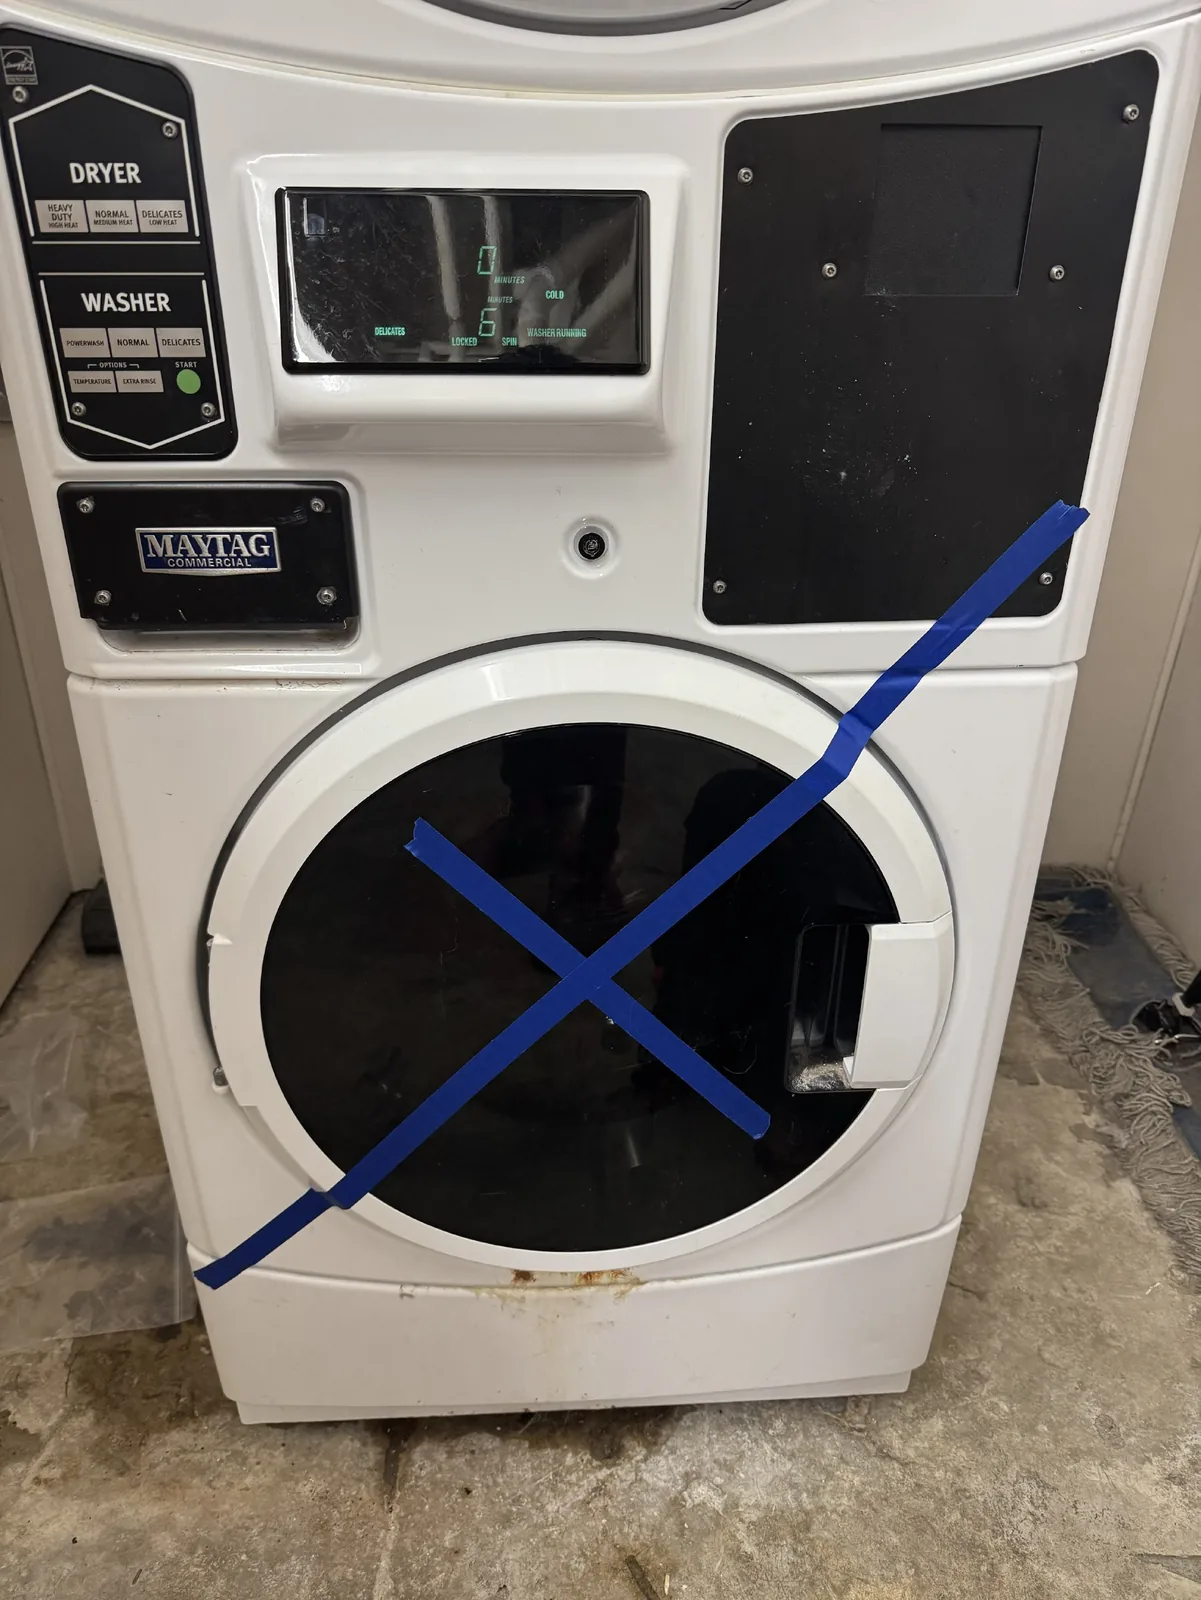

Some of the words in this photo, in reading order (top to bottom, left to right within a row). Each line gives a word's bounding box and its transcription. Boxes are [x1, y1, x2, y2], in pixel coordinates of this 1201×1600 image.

[69, 163, 141, 183] DRYER
[48, 204, 72, 212] HEAVY
[52, 213, 72, 221] DUTY
[477, 246, 497, 274] 0
[494, 275, 525, 284] MINUTES
[487, 295, 513, 303] MINUTES
[545, 290, 564, 299] COLD
[81, 293, 171, 312] WASHER
[479, 308, 498, 337] 6
[375, 327, 405, 336] DELICATES
[527, 328, 555, 337] WASHER
[555, 328, 587, 338] RUNNING
[452, 337, 477, 346] LOCKED
[502, 337, 517, 346] SPIN
[144, 534, 270, 557] MAYTAG
[168, 558, 252, 567] COMMERCIAL
